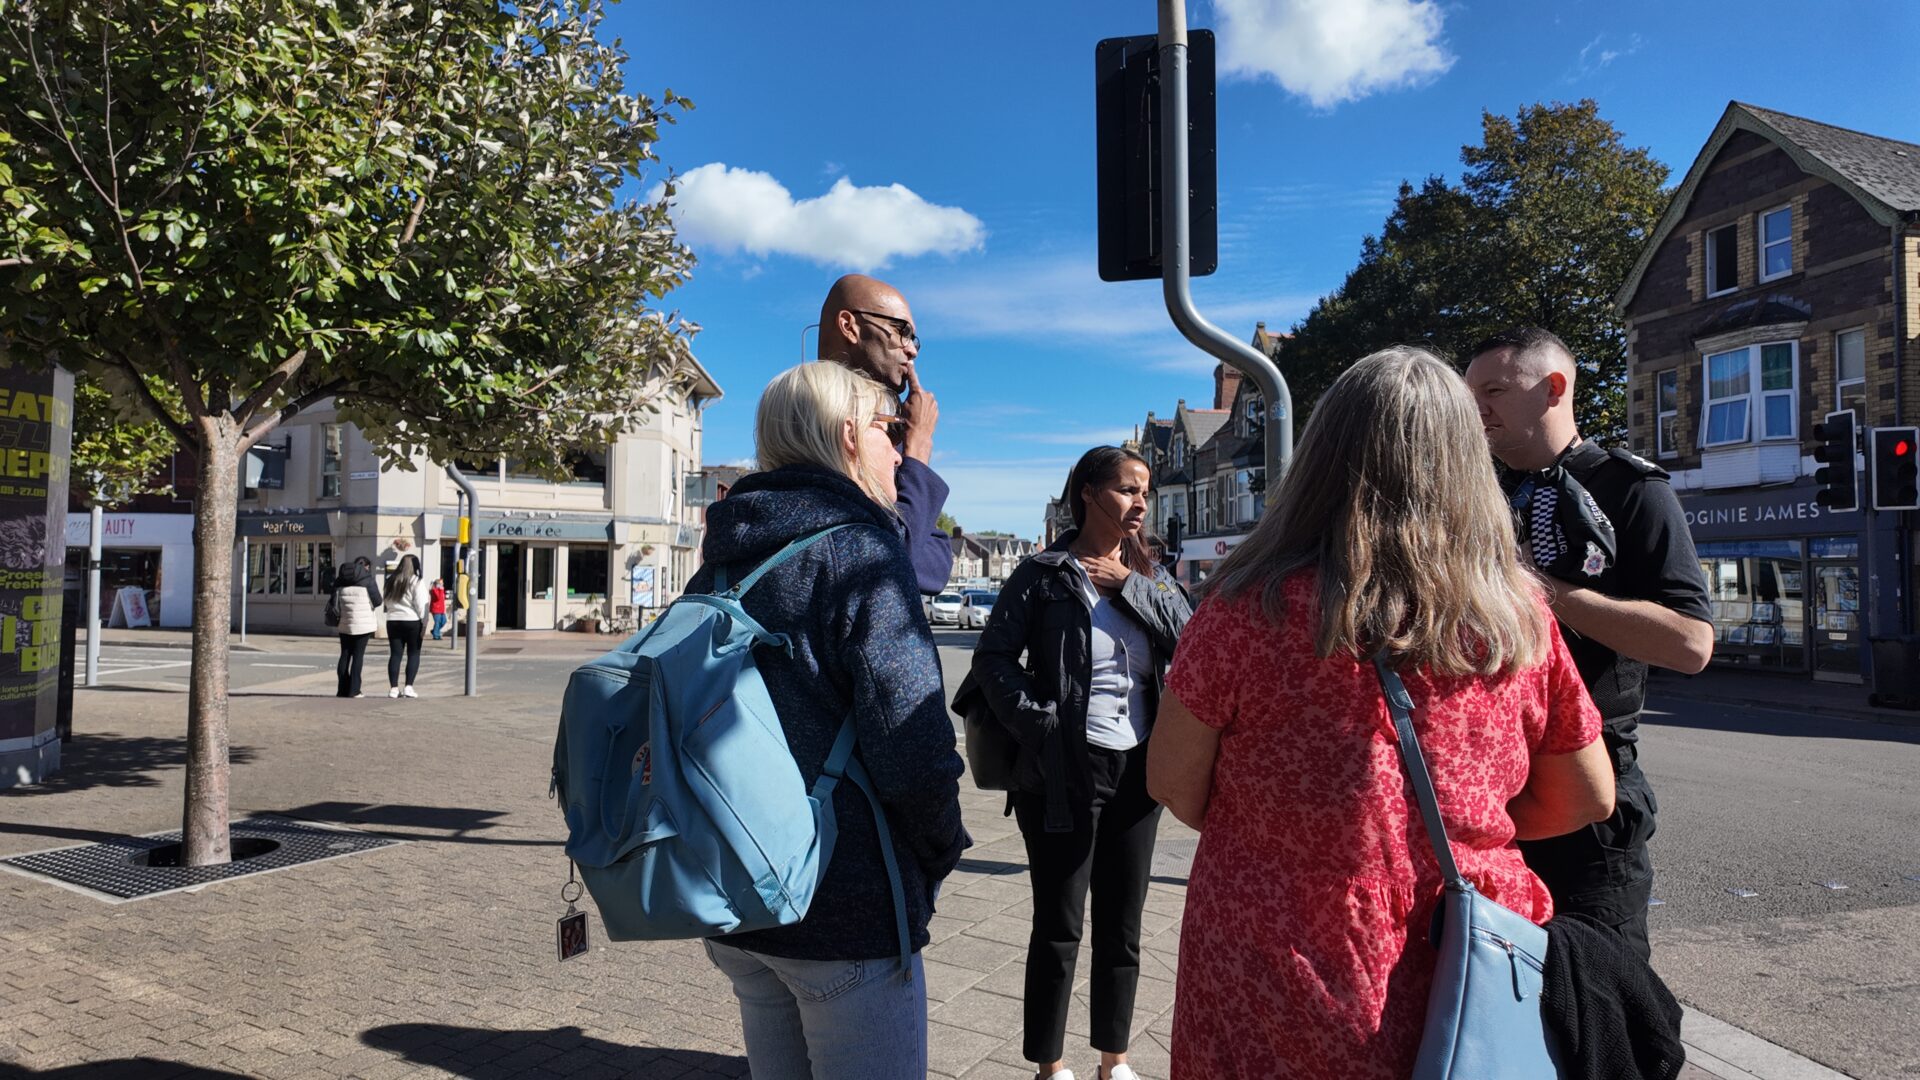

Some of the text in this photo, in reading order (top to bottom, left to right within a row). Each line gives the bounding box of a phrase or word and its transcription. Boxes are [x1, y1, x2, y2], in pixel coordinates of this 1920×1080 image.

[1583, 491, 1604, 524] HEDDLU
[1755, 502, 1820, 521] JAMES
[263, 520, 304, 534] Pear Tree
[498, 523, 562, 537] Pear Tee
[1555, 523, 1568, 555] POLIC
